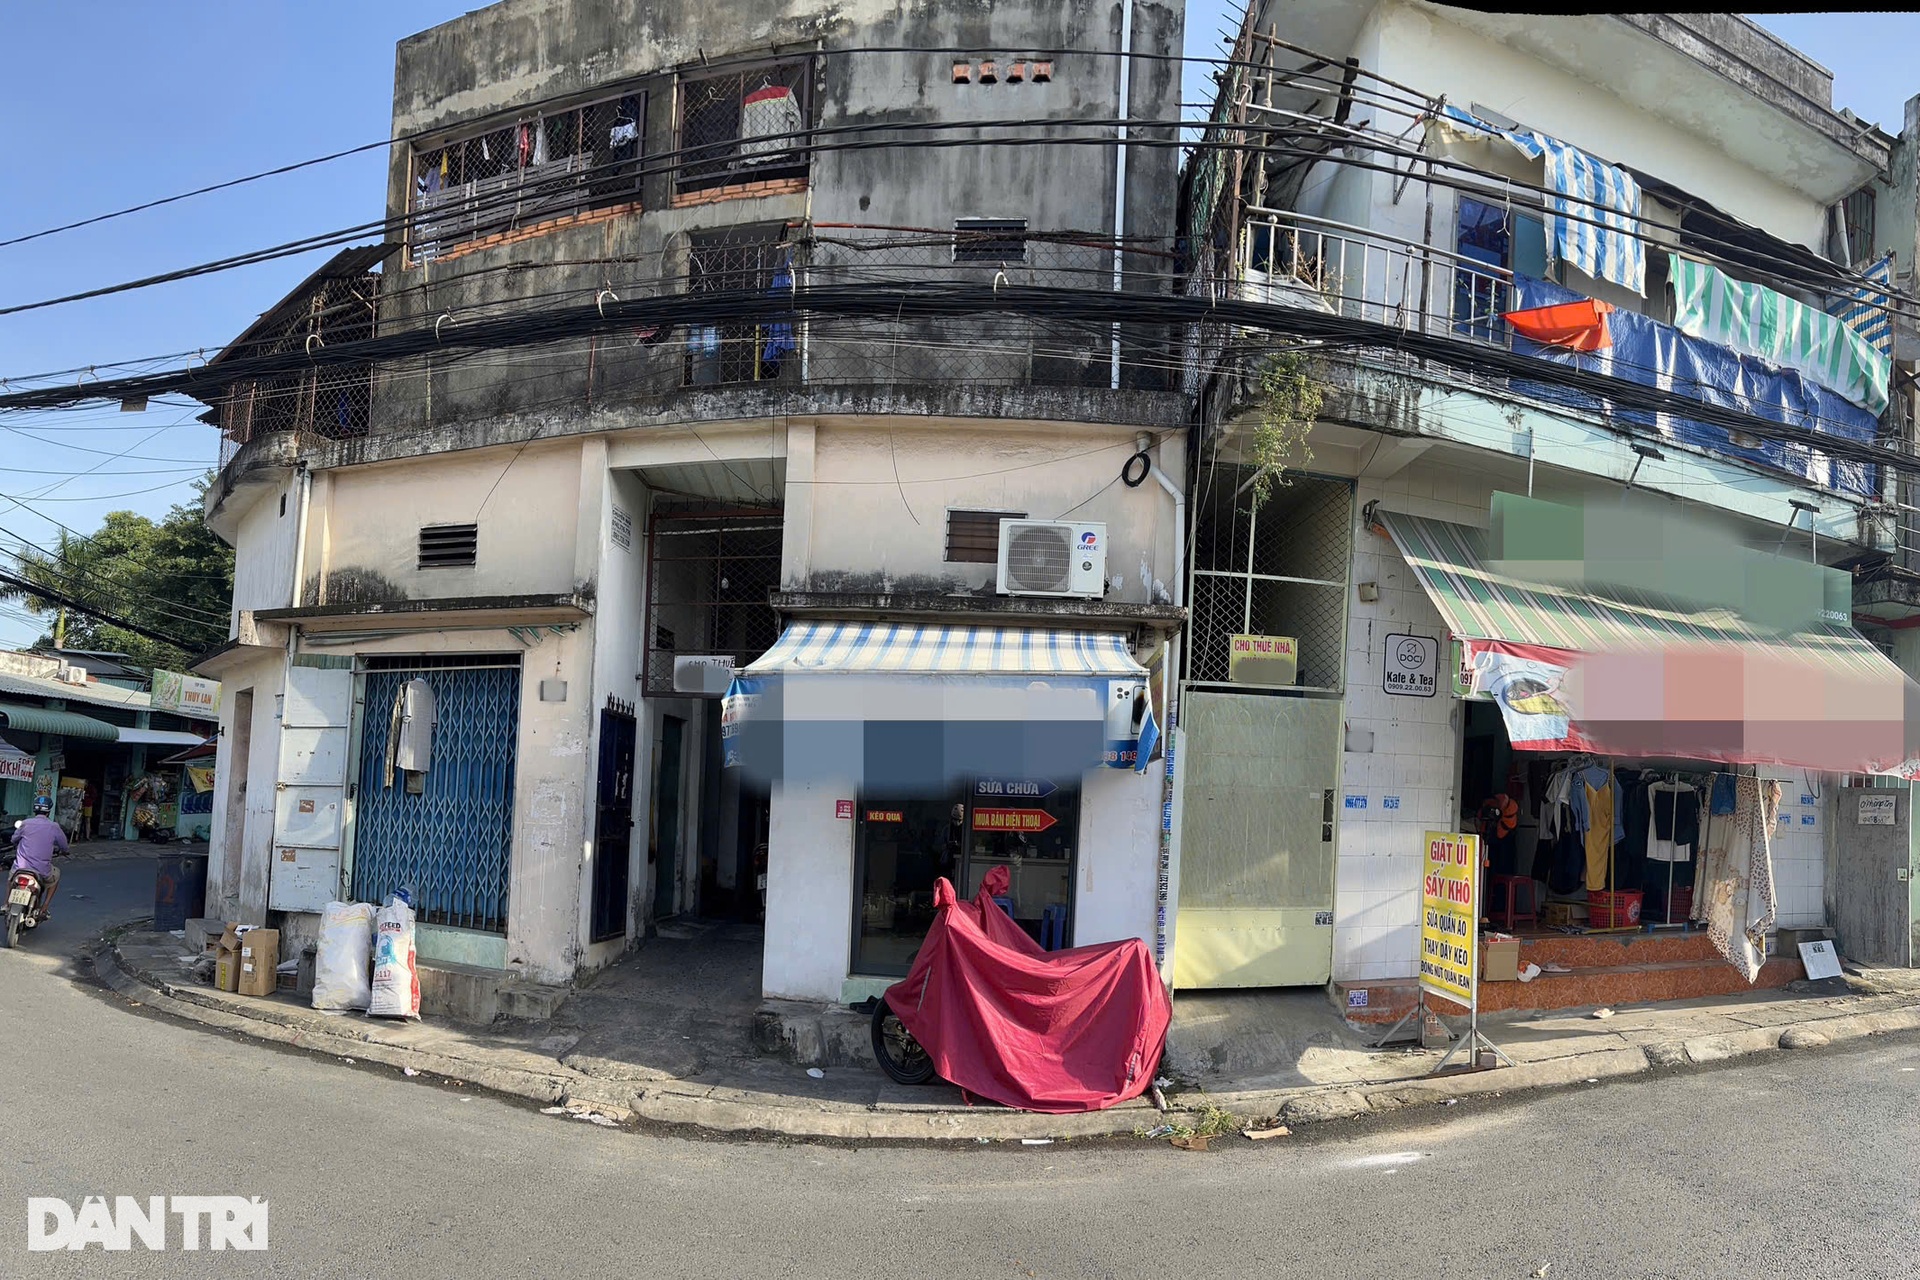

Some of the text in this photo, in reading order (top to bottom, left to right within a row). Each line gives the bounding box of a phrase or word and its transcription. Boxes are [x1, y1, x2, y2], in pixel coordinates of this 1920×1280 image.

[1234, 640, 1250, 651] CHO
[1400, 654, 1423, 663] DOCI
[1386, 671, 1434, 686] Kafe & Tea
[979, 777, 1040, 795] SỬA CHỮA
[886, 812, 901, 822] QUA
[975, 812, 989, 827] MUA
[991, 810, 1005, 827] BÁN
[1020, 812, 1041, 830] THOẠI
[1430, 836, 1468, 868] GIẶT ỦI
[1425, 870, 1471, 904] SẤY KHÔ
[1426, 907, 1438, 929] SỬA
[1458, 918, 1467, 937] ÁO
[1424, 938, 1468, 966] THAY DÂY KÉO
[1434, 963, 1443, 979] NÚT
[1457, 974, 1470, 990] JEAN
